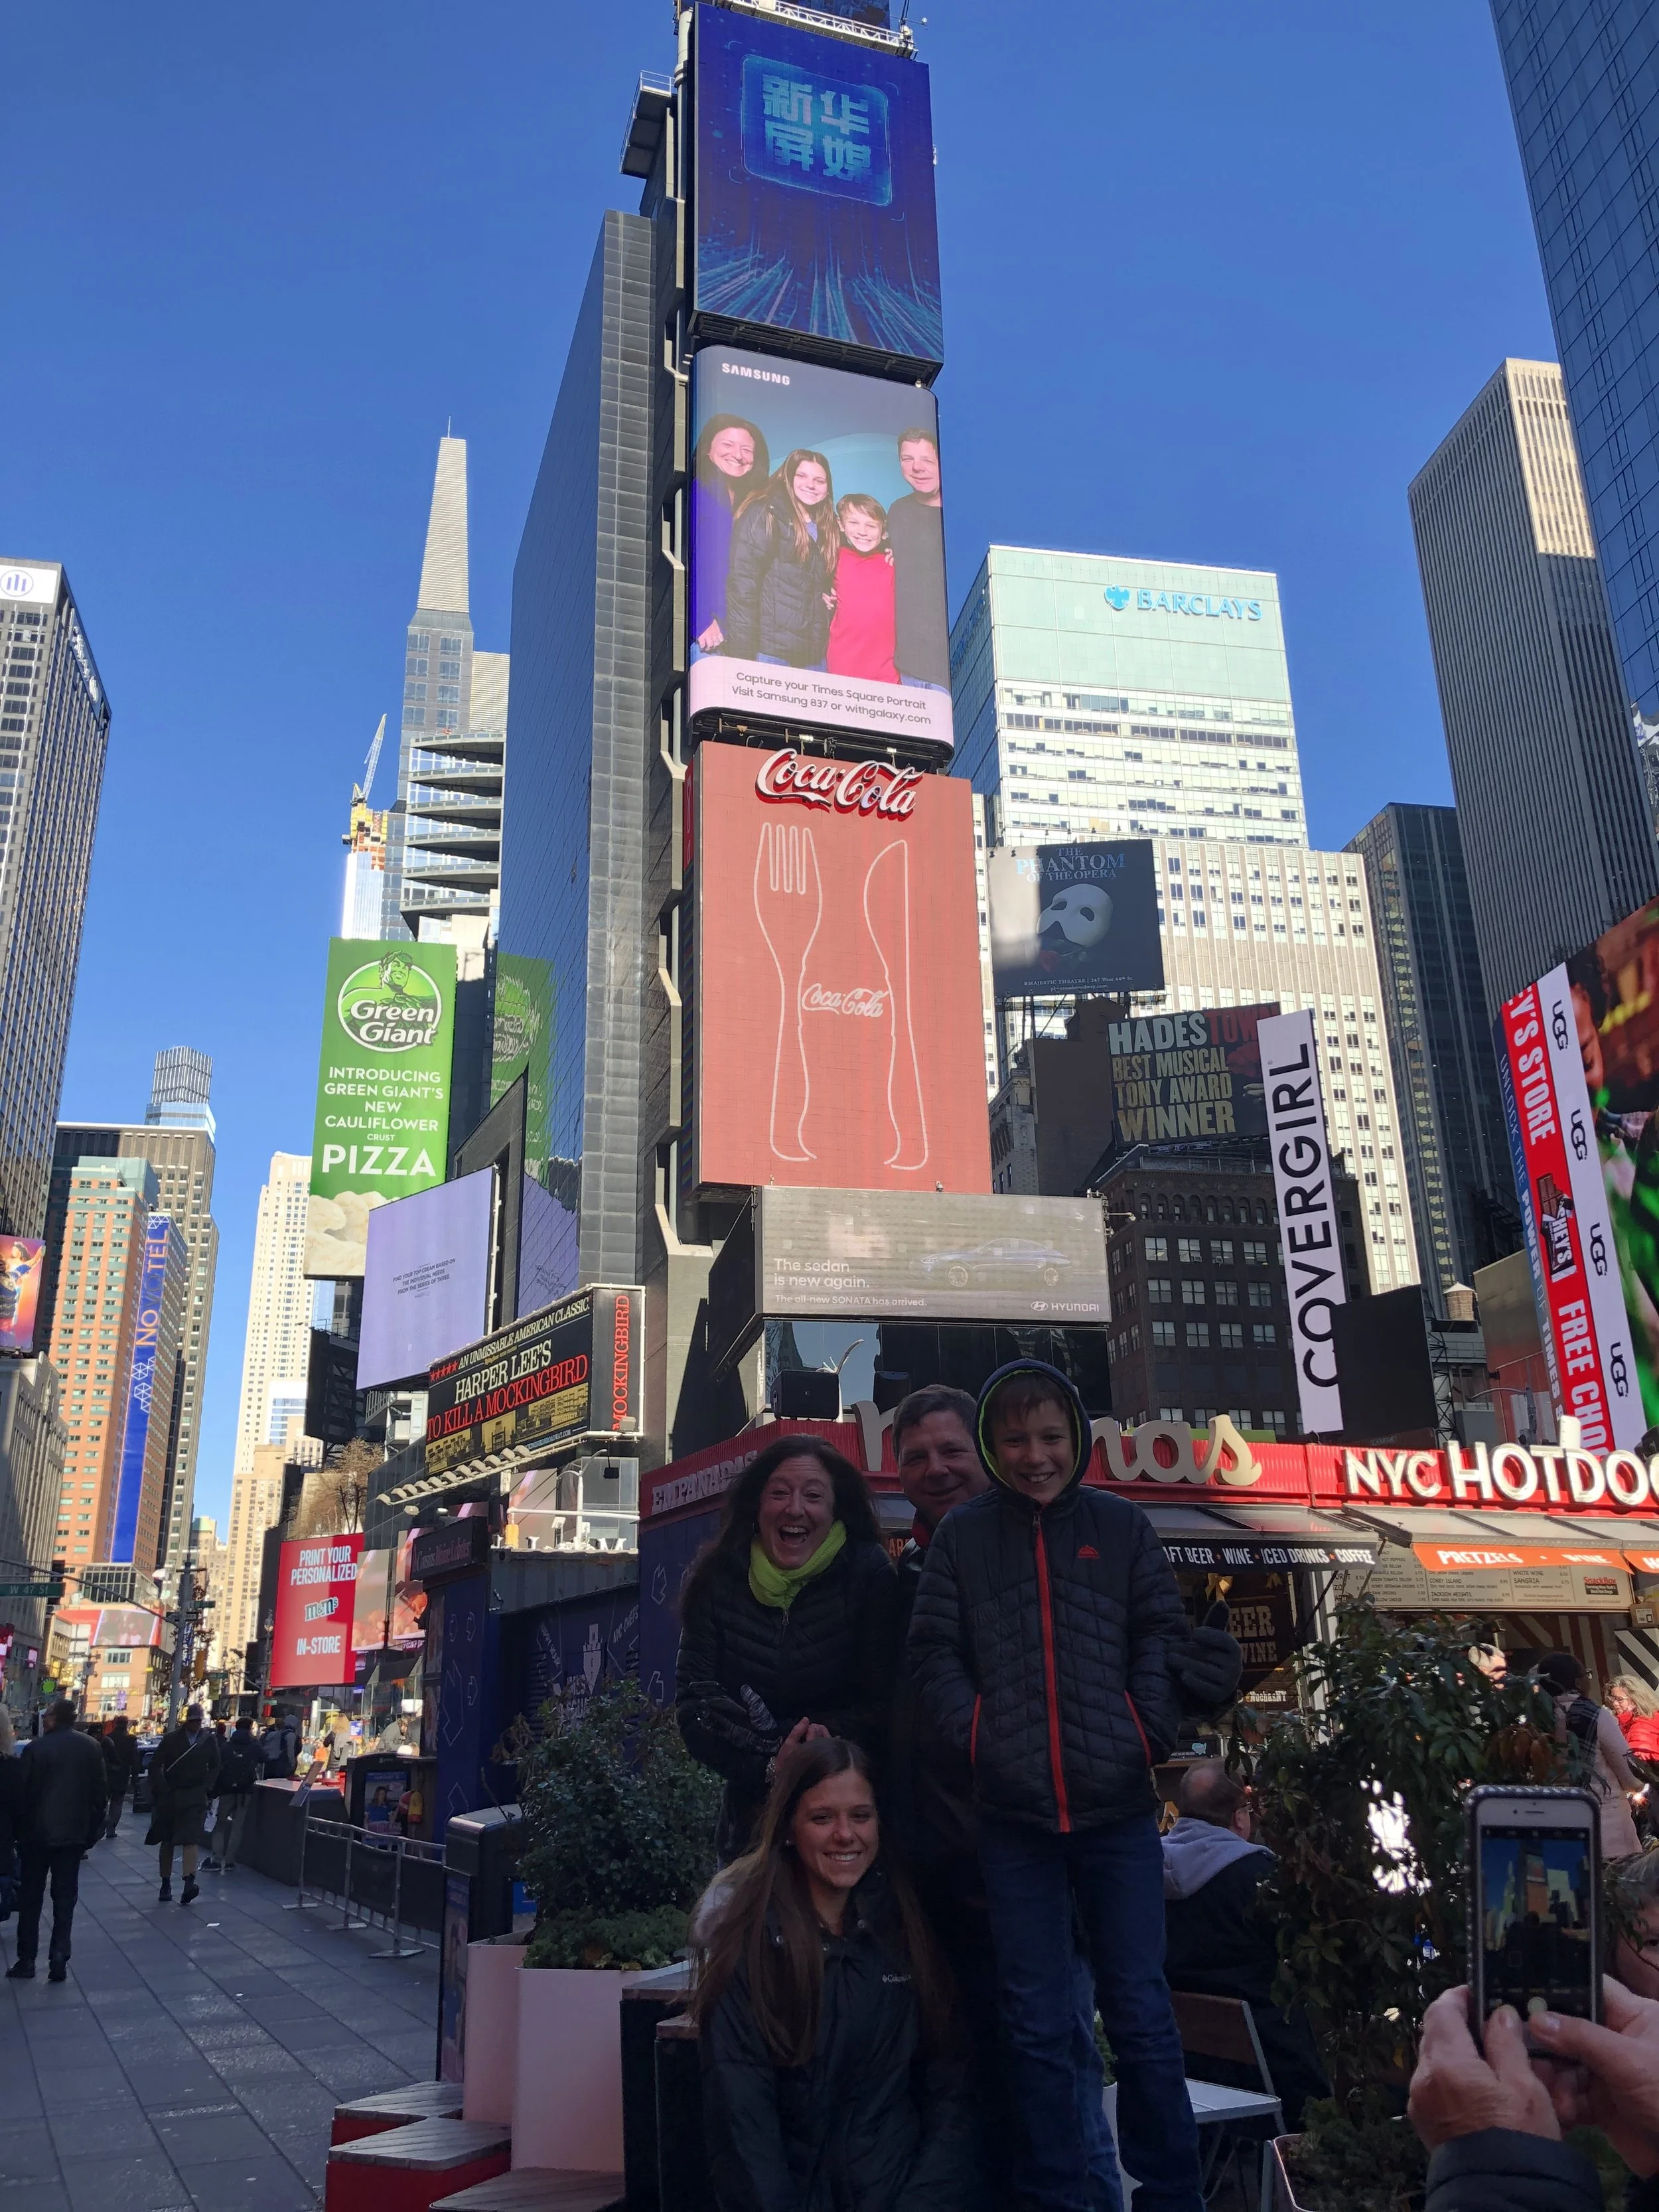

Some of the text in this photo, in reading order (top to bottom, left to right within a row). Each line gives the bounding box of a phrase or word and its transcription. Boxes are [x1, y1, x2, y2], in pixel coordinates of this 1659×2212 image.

[762, 74, 869, 135] 新华
[722, 362, 790, 385] SAMSUNG
[1137, 590, 1262, 620] BARCLAYS
[732, 686, 755, 698] Visit
[757, 690, 808, 708] Samsung
[810, 698, 828, 709] 837
[845, 703, 932, 725] withgalaxy.com
[736, 672, 926, 710] Capture your Times Square Portrait
[1015, 853, 1125, 874] PHANTOM
[1055, 847, 1083, 857] THE
[1027, 868, 1118, 883] OF THE OPERA
[350, 999, 435, 1023] Green
[1552, 999, 1568, 1051] UGG
[359, 1021, 435, 1045] Giant
[1108, 1003, 1278, 1055] HADESTOW
[329, 1067, 441, 1084] INTRODUCING
[1112, 1046, 1229, 1082] BEST MUSICAL
[1508, 986, 1555, 1146] Y'S STORE
[325, 1082, 444, 1100] GREEN GIANT'S
[1115, 1072, 1233, 1108] TONY AWARD
[1500, 1053, 1520, 1141] UNLOCK
[364, 1100, 401, 1114] NEW
[1117, 1100, 1236, 1142] WINNER
[325, 1115, 439, 1132] CAULIFLOWER
[366, 1133, 396, 1142] CRUST
[1570, 1108, 1587, 1161] UGG
[321, 1144, 437, 1177] PIZZA
[1515, 1143, 1526, 1188] THE
[1267, 1043, 1339, 1388] COVERGIRL
[1521, 1189, 1541, 1280] POWER
[1589, 1222, 1607, 1277] UGG
[402, 1271, 413, 1280] YOUR
[421, 1265, 435, 1274] CREAM
[435, 1260, 449, 1269] BASED
[774, 1258, 849, 1272] The sedan
[136, 1229, 168, 1347] NOVOTEL
[417, 1280, 430, 1289] SERIES
[437, 1274, 450, 1282] THREE
[774, 1274, 870, 1290] is new again.
[795, 1296, 831, 1305] all-new
[832, 1296, 871, 1305] SONATA
[892, 1298, 927, 1307] arrived.
[1050, 1303, 1100, 1312] HYUNDAI
[1536, 1284, 1548, 1312] OF
[458, 1355, 470, 1370] AN
[470, 1333, 513, 1364] UNMISSABLE
[514, 1313, 555, 1343] AMERICAN
[1559, 1299, 1595, 1376] FREE
[454, 1360, 508, 1404] HARPER
[510, 1339, 552, 1381] LEE'S
[1541, 1317, 1560, 1400] TIMES
[1610, 1341, 1628, 1398] UGG
[427, 1414, 442, 1441] TO
[443, 1402, 473, 1435] KILL
[474, 1398, 484, 1422] A
[484, 1354, 589, 1416] MOCKINGBIRD
[1344, 1439, 1659, 1506] NYC HOTDO
[299, 1545, 352, 1567] PRINT YOUR
[1185, 1547, 1215, 1564] BEER
[1222, 1548, 1254, 1564] WINE
[1261, 1548, 1288, 1564] ICED
[1289, 1548, 1329, 1564] DRINKS
[1334, 1548, 1376, 1565] COFFEE
[1437, 1550, 1612, 1564] PRETZELS WINE
[10, 1585, 48, 1594] W 47 St
[291, 1562, 358, 1586] PERSONALIZED
[1229, 1605, 1275, 1638] EER
[296, 1635, 341, 1656] IN-STORE
